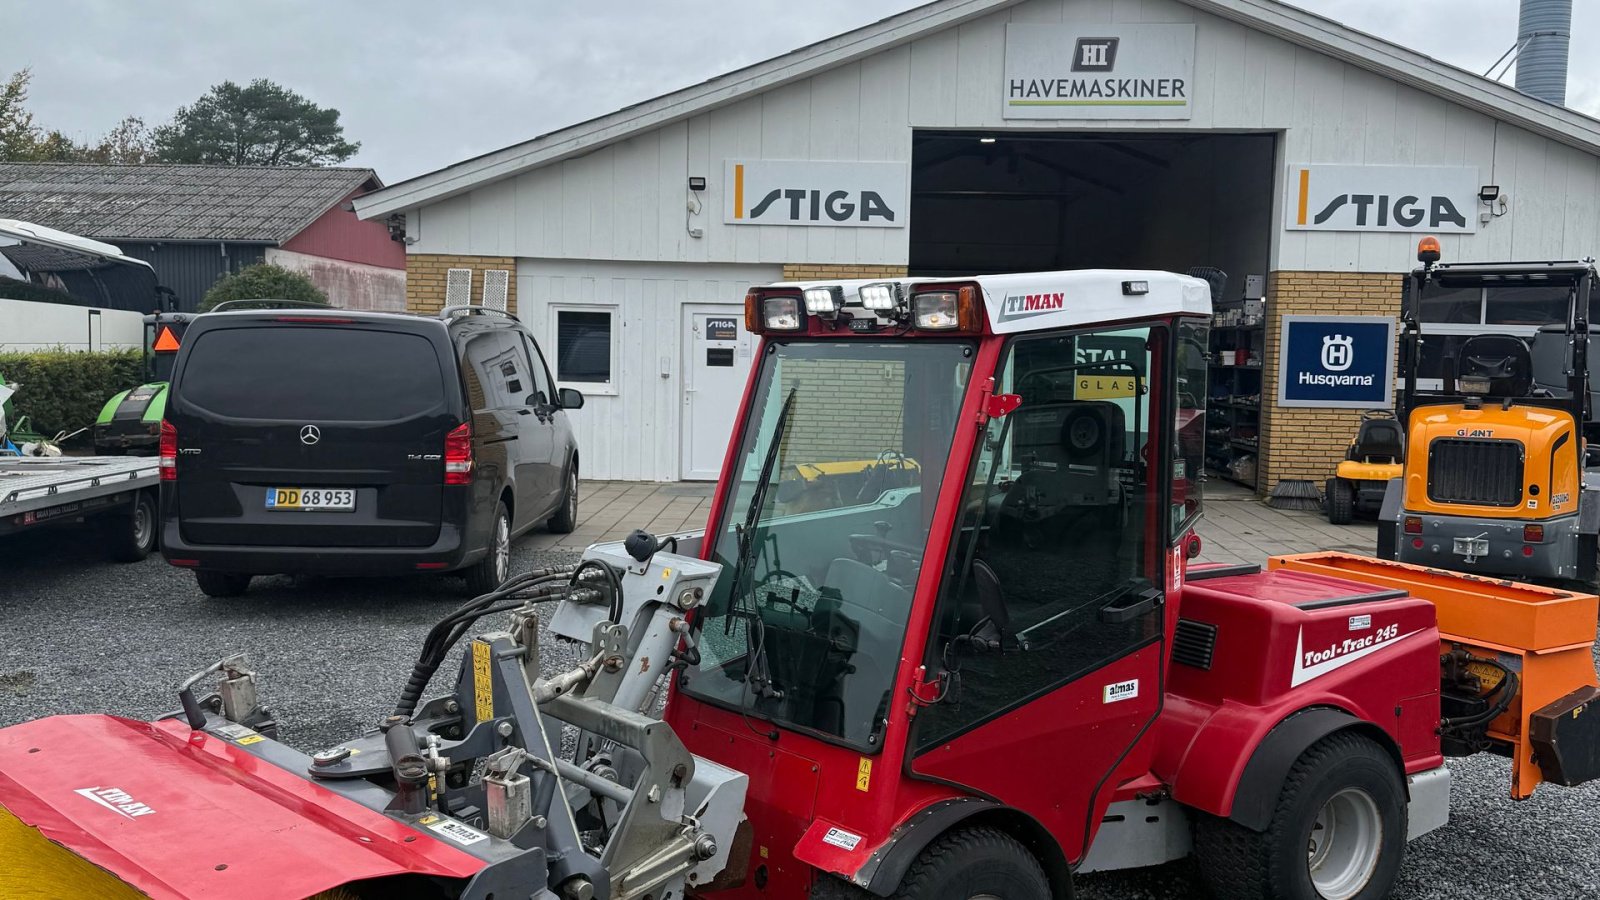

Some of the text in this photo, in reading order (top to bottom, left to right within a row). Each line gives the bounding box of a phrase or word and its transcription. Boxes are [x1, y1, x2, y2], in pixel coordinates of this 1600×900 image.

[1081, 44, 1108, 66] HI
[1010, 78, 1186, 98] HAVEMASKINER
[750, 188, 895, 222] STIGA
[1313, 193, 1466, 228] STIGA
[1007, 292, 1065, 312] TIMAN
[1299, 371, 1373, 387] Husqvarna
[277, 490, 299, 504] DD
[302, 490, 320, 505] 68
[324, 491, 352, 505] 953
[1304, 623, 1399, 667] Tool-Trac 245
[1109, 682, 1135, 696] almas
[443, 823, 480, 841] almas
